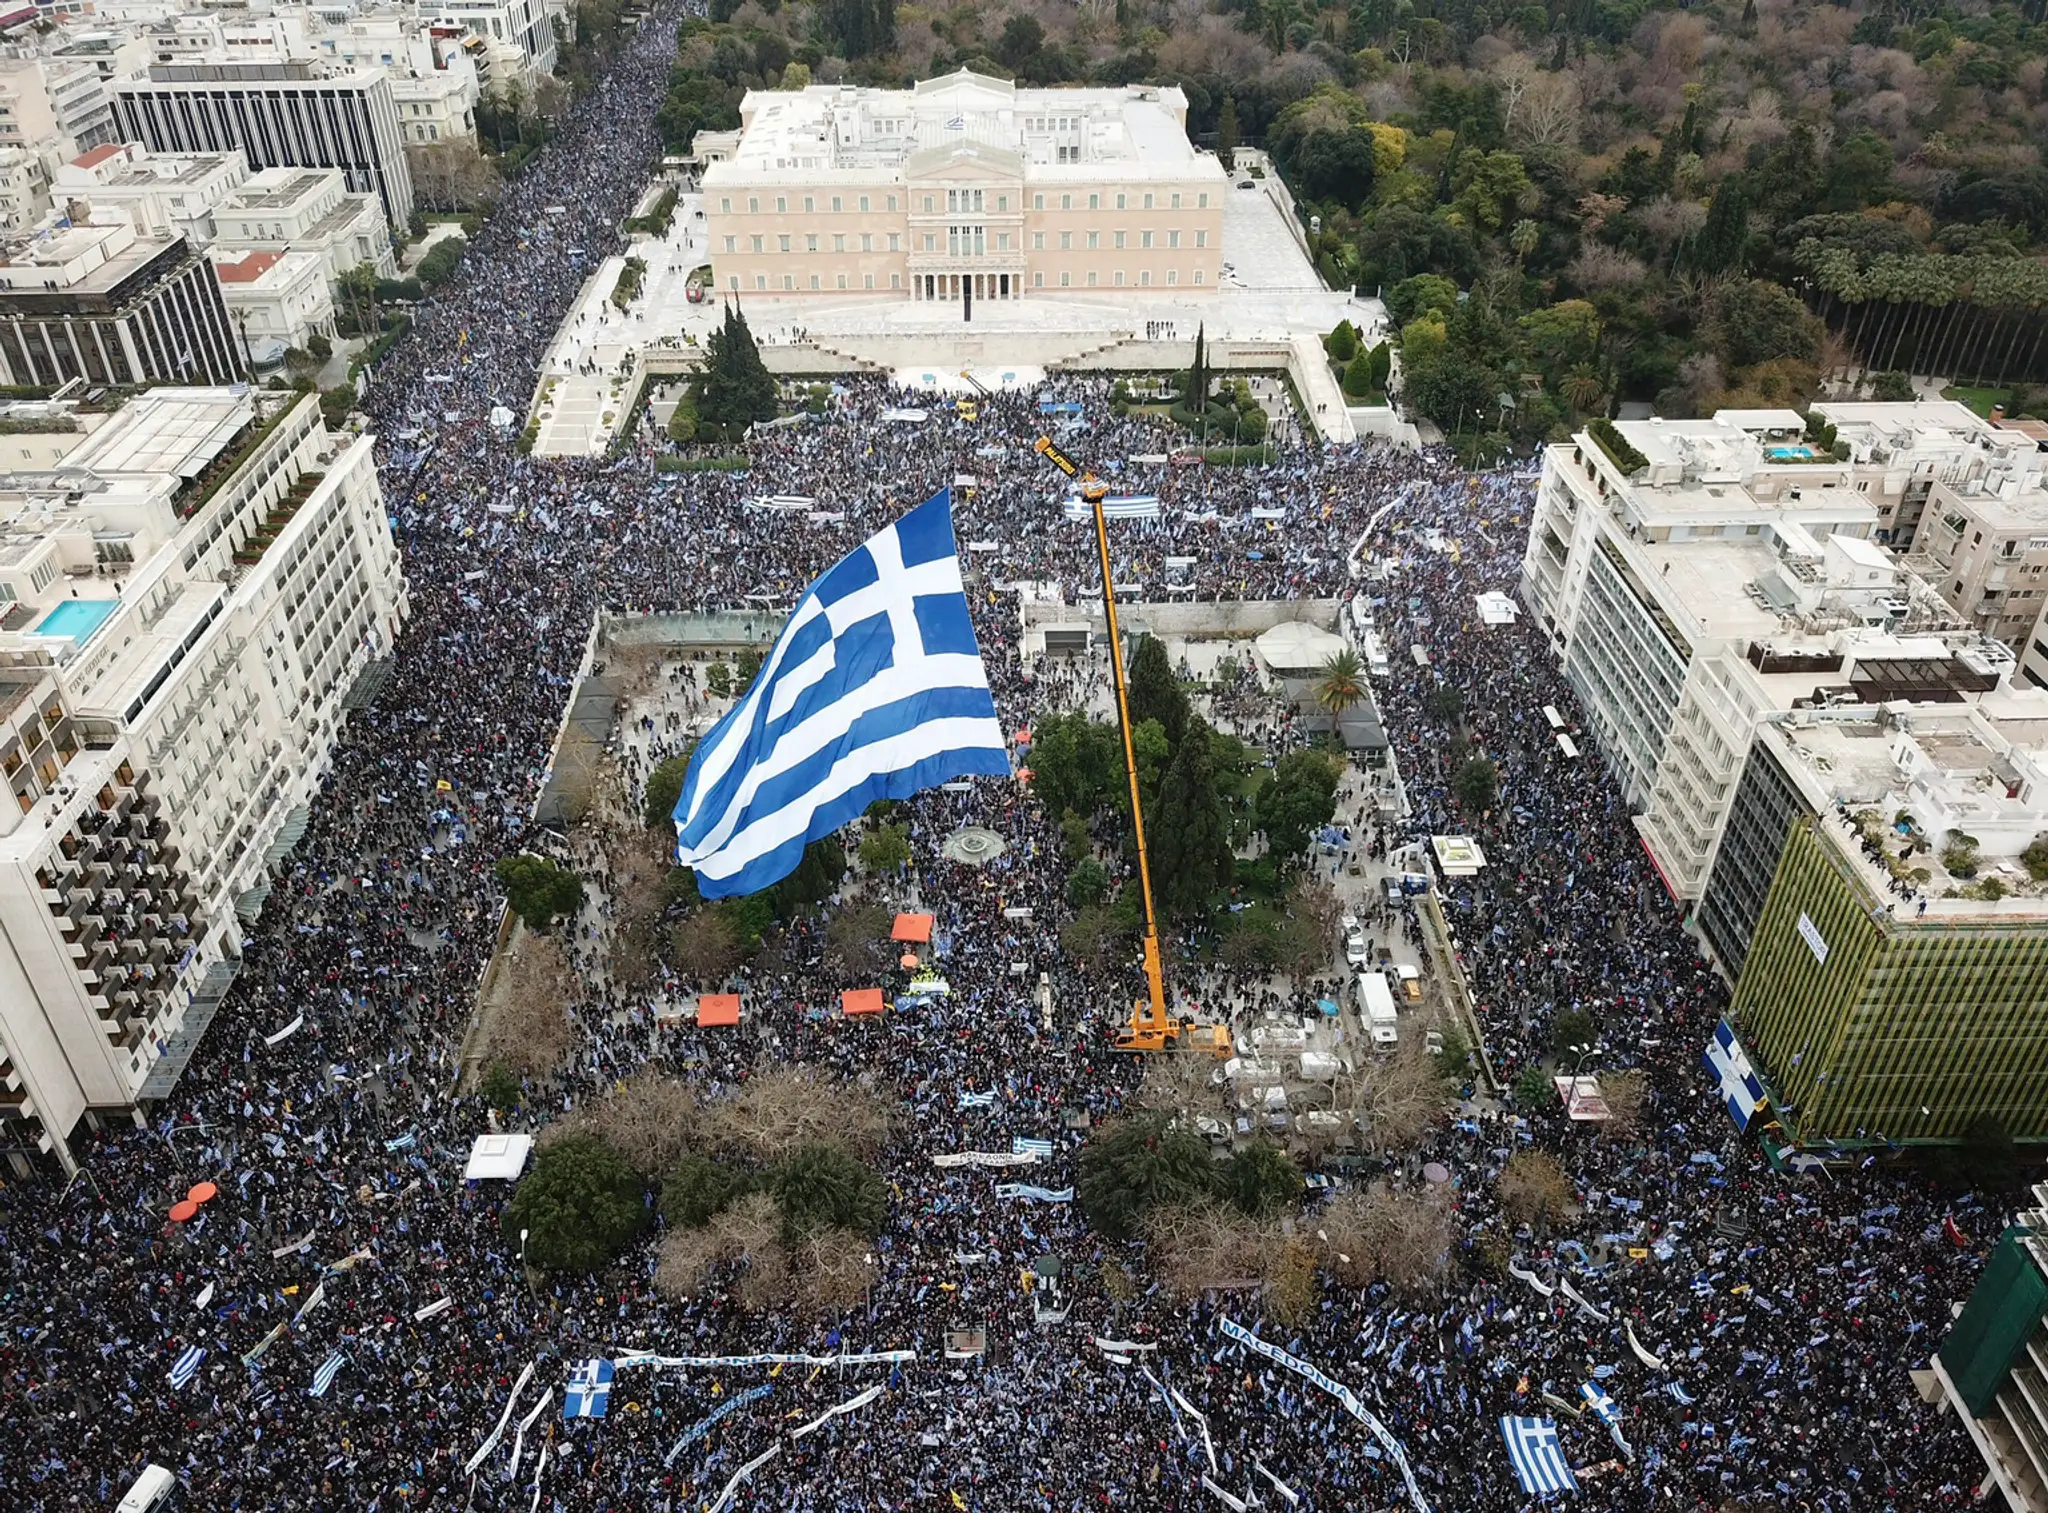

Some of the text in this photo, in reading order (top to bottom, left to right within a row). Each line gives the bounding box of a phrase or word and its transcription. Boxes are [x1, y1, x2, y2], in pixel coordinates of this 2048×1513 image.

[625, 1354, 774, 1367] MADONIA
[1222, 1320, 1348, 1402] MACEDONIA
[1354, 1404, 1372, 1425] IS
